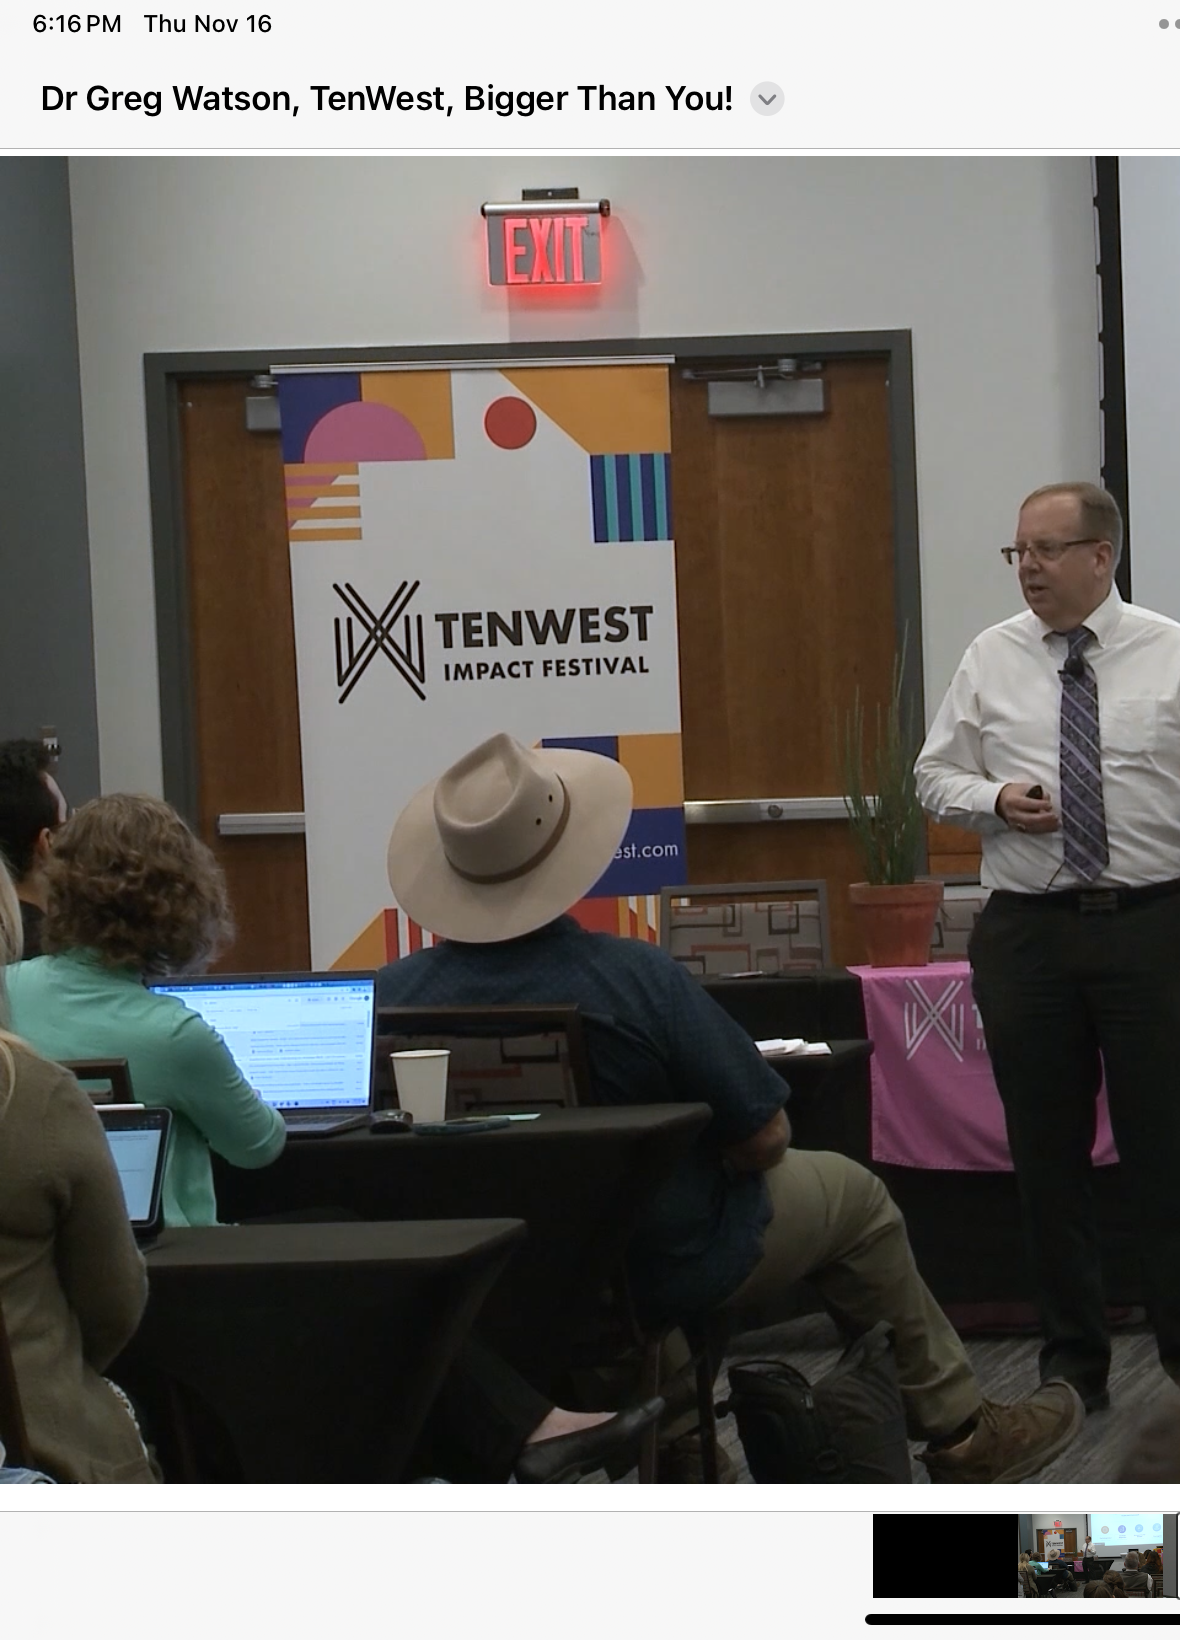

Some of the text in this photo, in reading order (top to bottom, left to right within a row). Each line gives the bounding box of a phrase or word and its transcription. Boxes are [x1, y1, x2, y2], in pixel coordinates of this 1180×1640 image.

[504, 216, 588, 284] EXIT
[434, 604, 655, 651] TENWEST
[443, 655, 651, 683] IMPACT FESTIVAL
